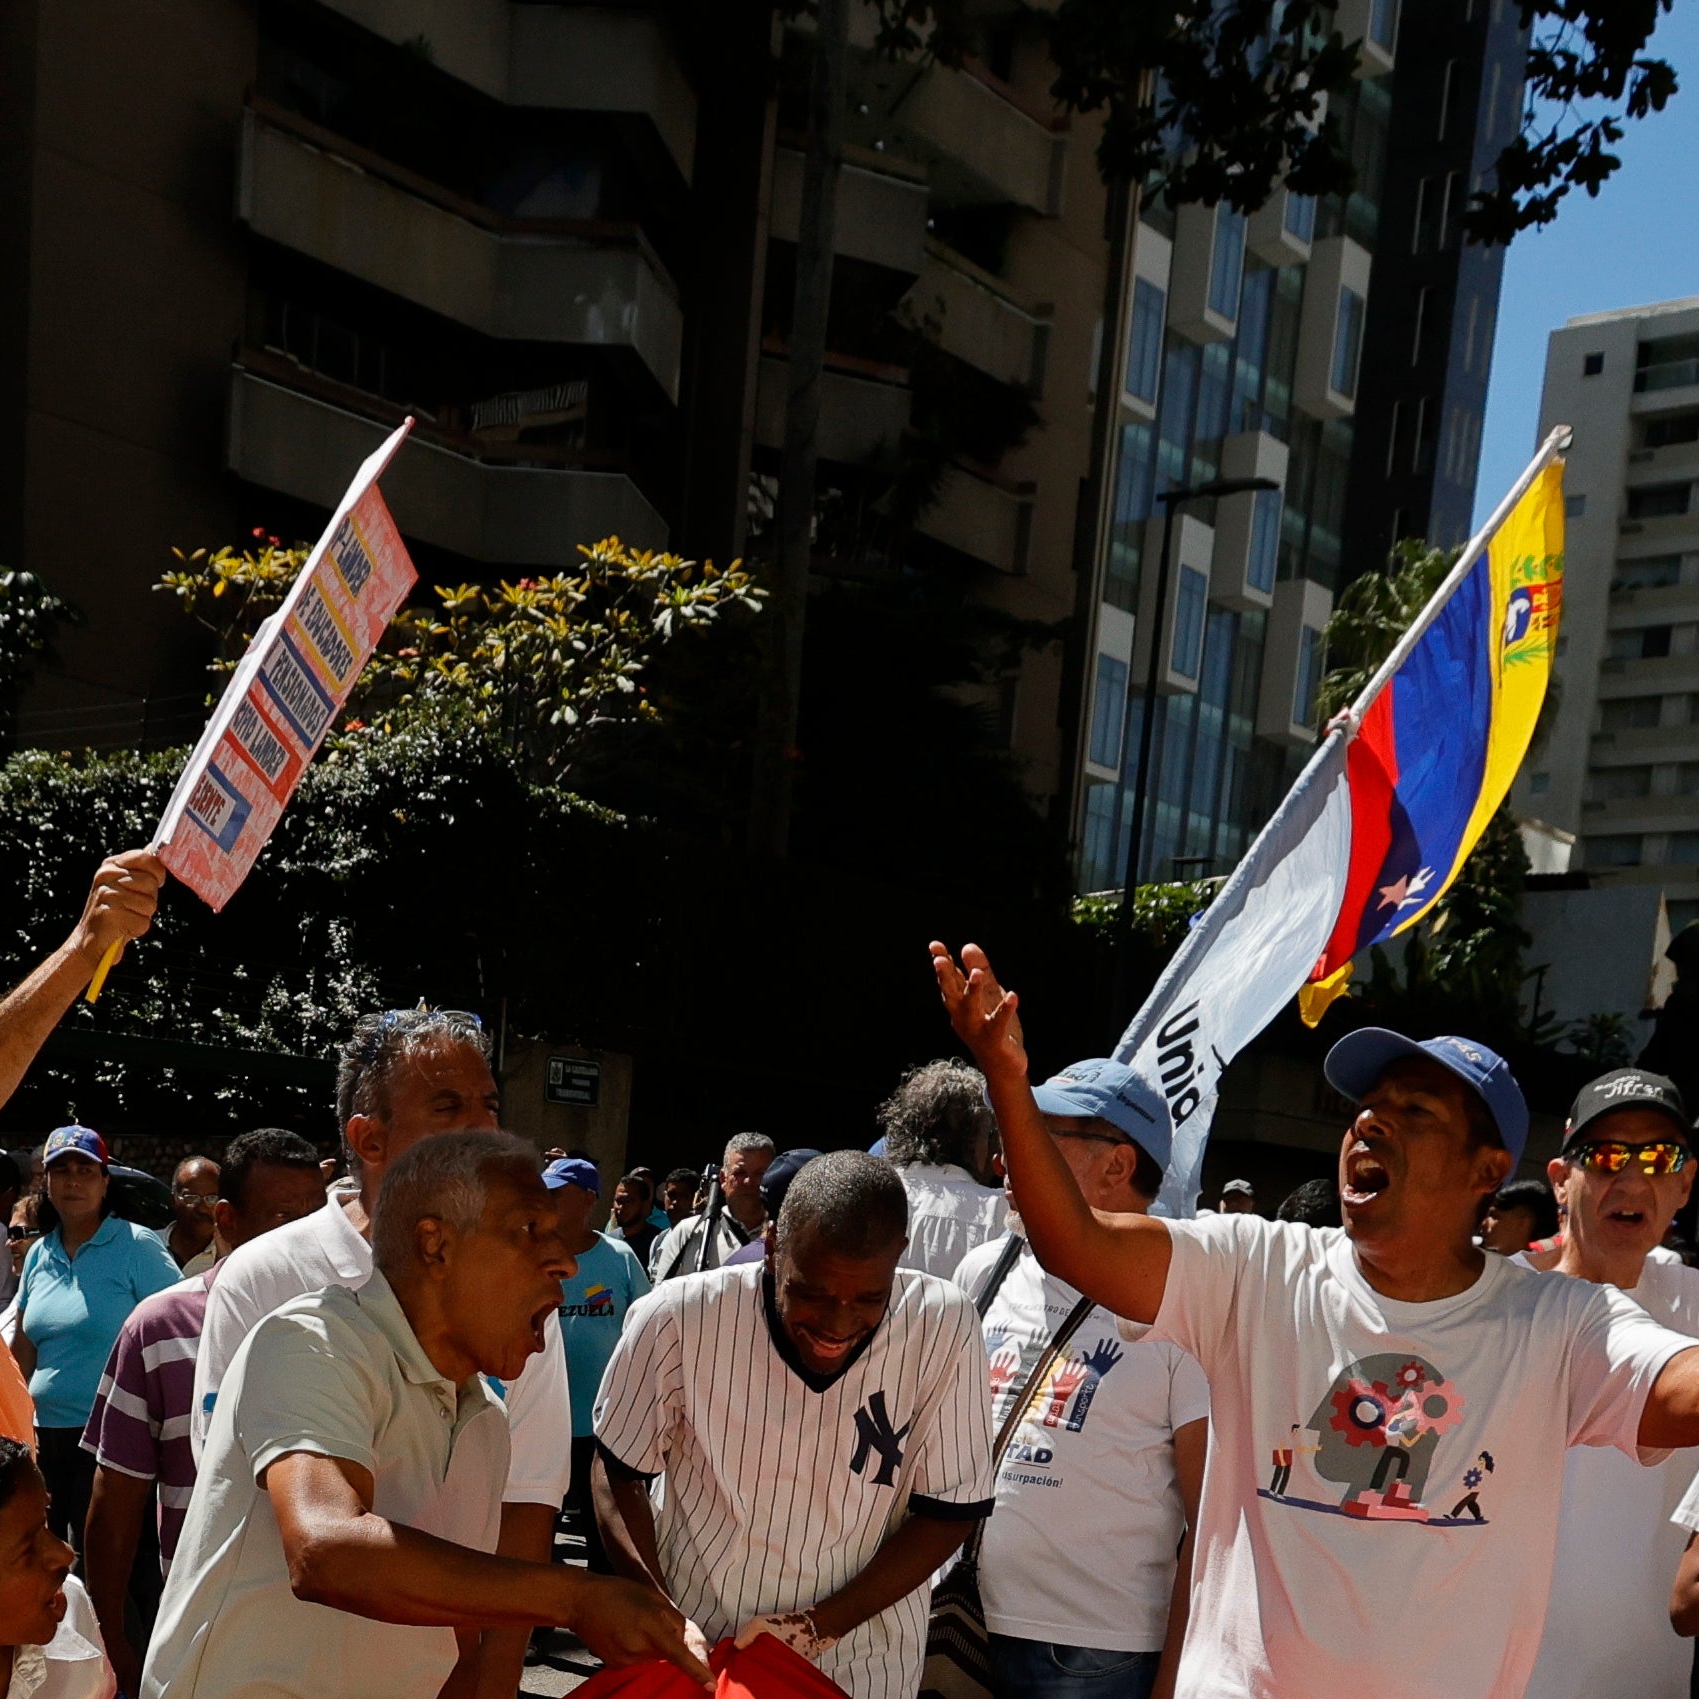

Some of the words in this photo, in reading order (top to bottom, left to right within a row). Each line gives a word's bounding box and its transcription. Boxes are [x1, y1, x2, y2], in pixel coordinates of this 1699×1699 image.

[304, 599, 354, 683] EDUCADORES
[270, 646, 326, 739] PENSIONADOS
[248, 723, 286, 781] LANDER
[849, 1389, 911, 1489] NY
